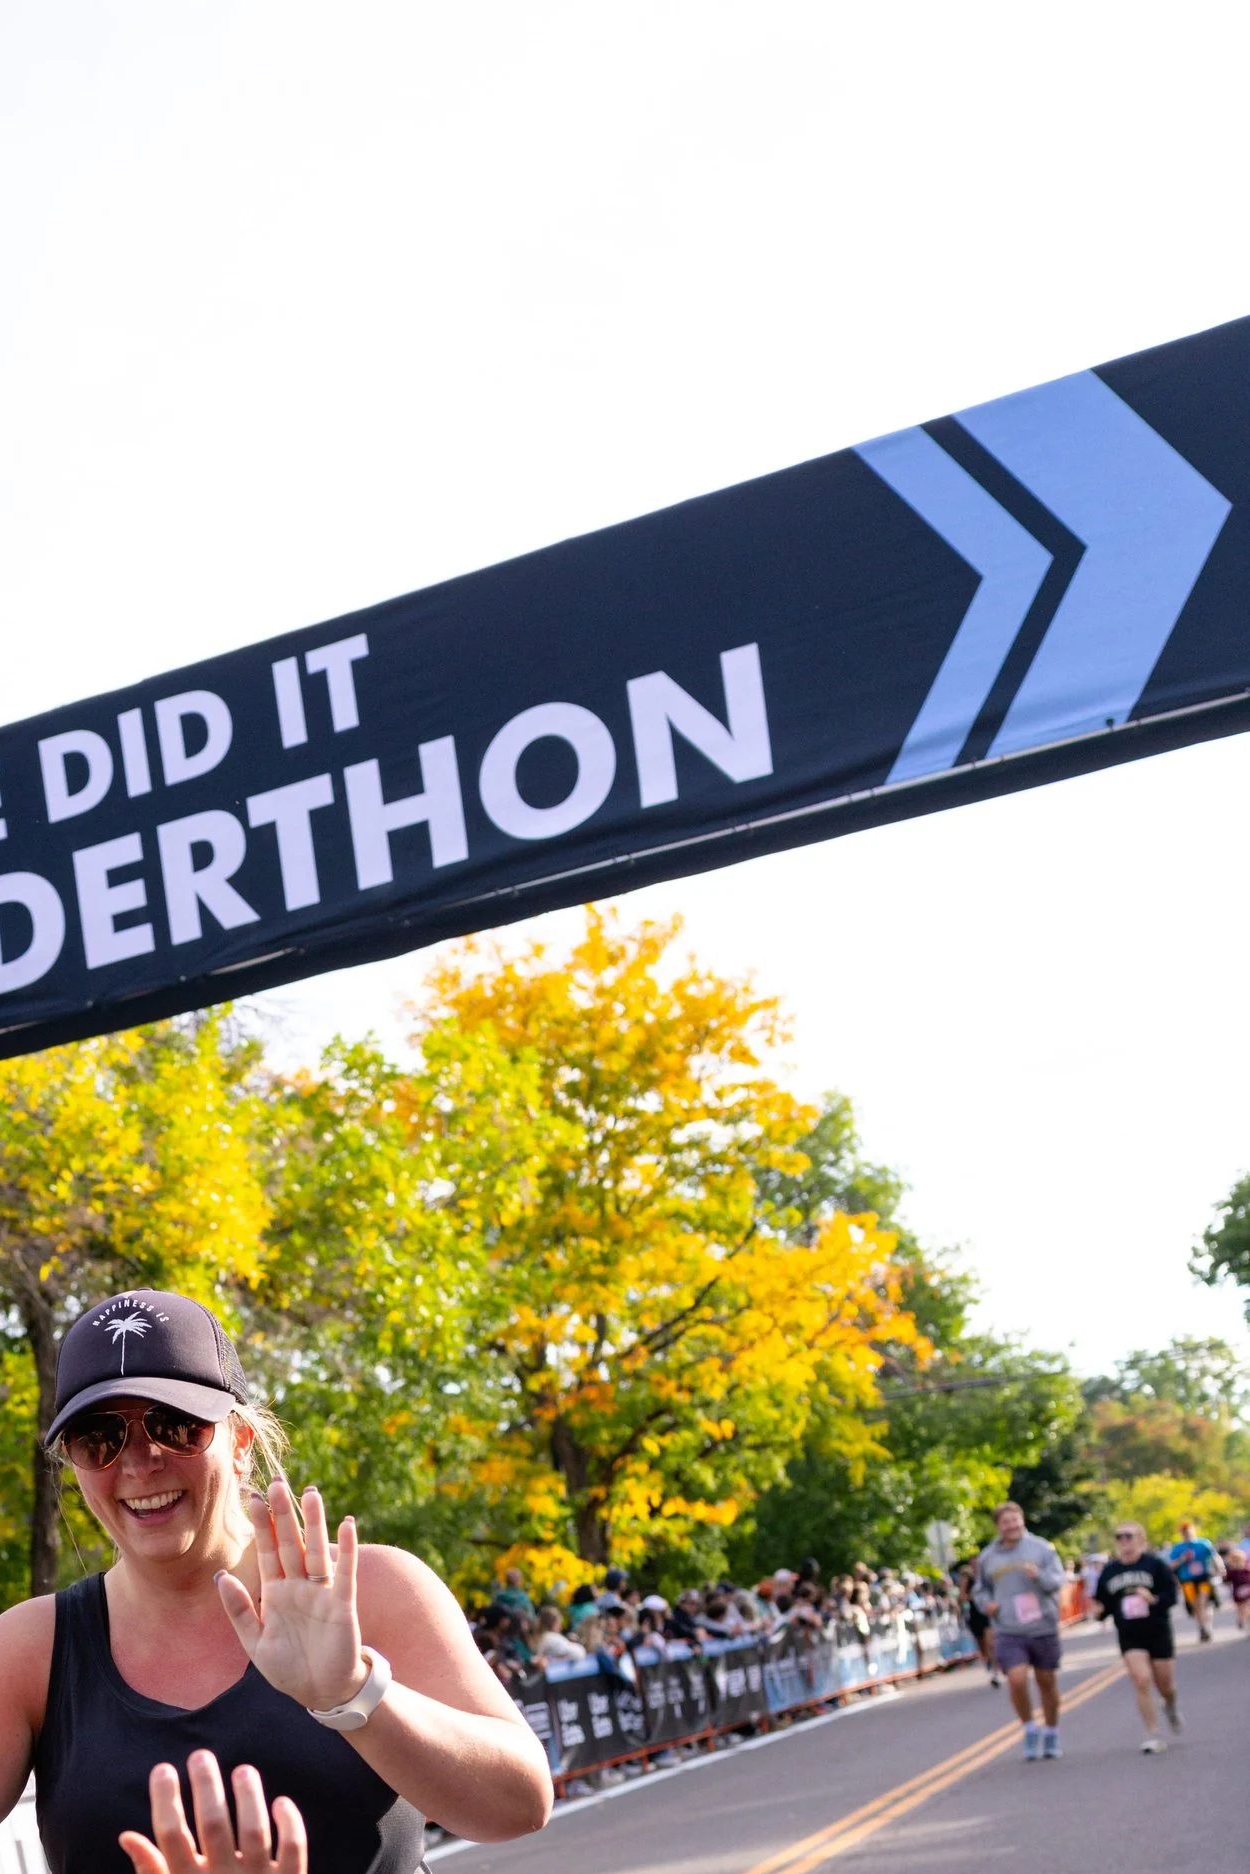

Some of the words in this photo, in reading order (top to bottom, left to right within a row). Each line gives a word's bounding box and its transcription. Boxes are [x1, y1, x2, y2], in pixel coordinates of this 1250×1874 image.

[38, 690, 233, 823] DID
[272, 633, 369, 748] IT
[92, 1299, 155, 1327] HAPPINESS
[156, 1312, 170, 1322] IS
